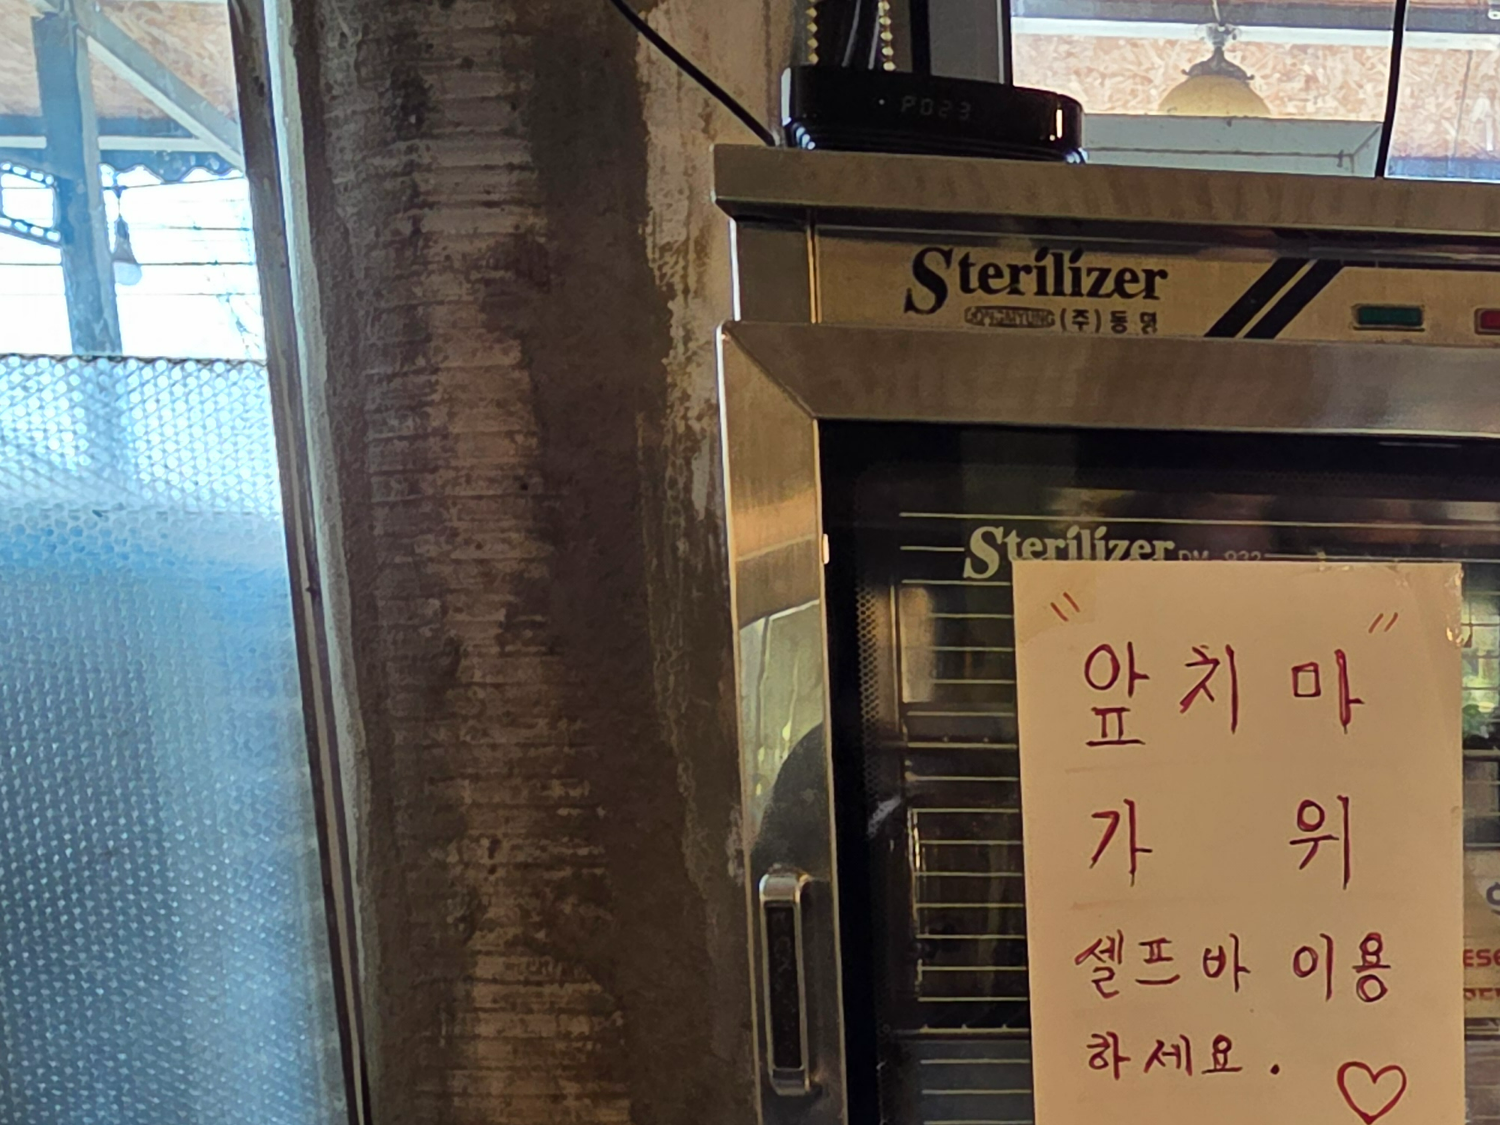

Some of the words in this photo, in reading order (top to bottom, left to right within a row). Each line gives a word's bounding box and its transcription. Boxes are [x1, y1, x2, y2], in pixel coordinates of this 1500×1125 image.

[904, 246, 1169, 315] Sterilizer
[963, 525, 1176, 580] Sterilizer
[1074, 929, 1251, 999] 셀프바
[1292, 932, 1391, 1002] 이용
